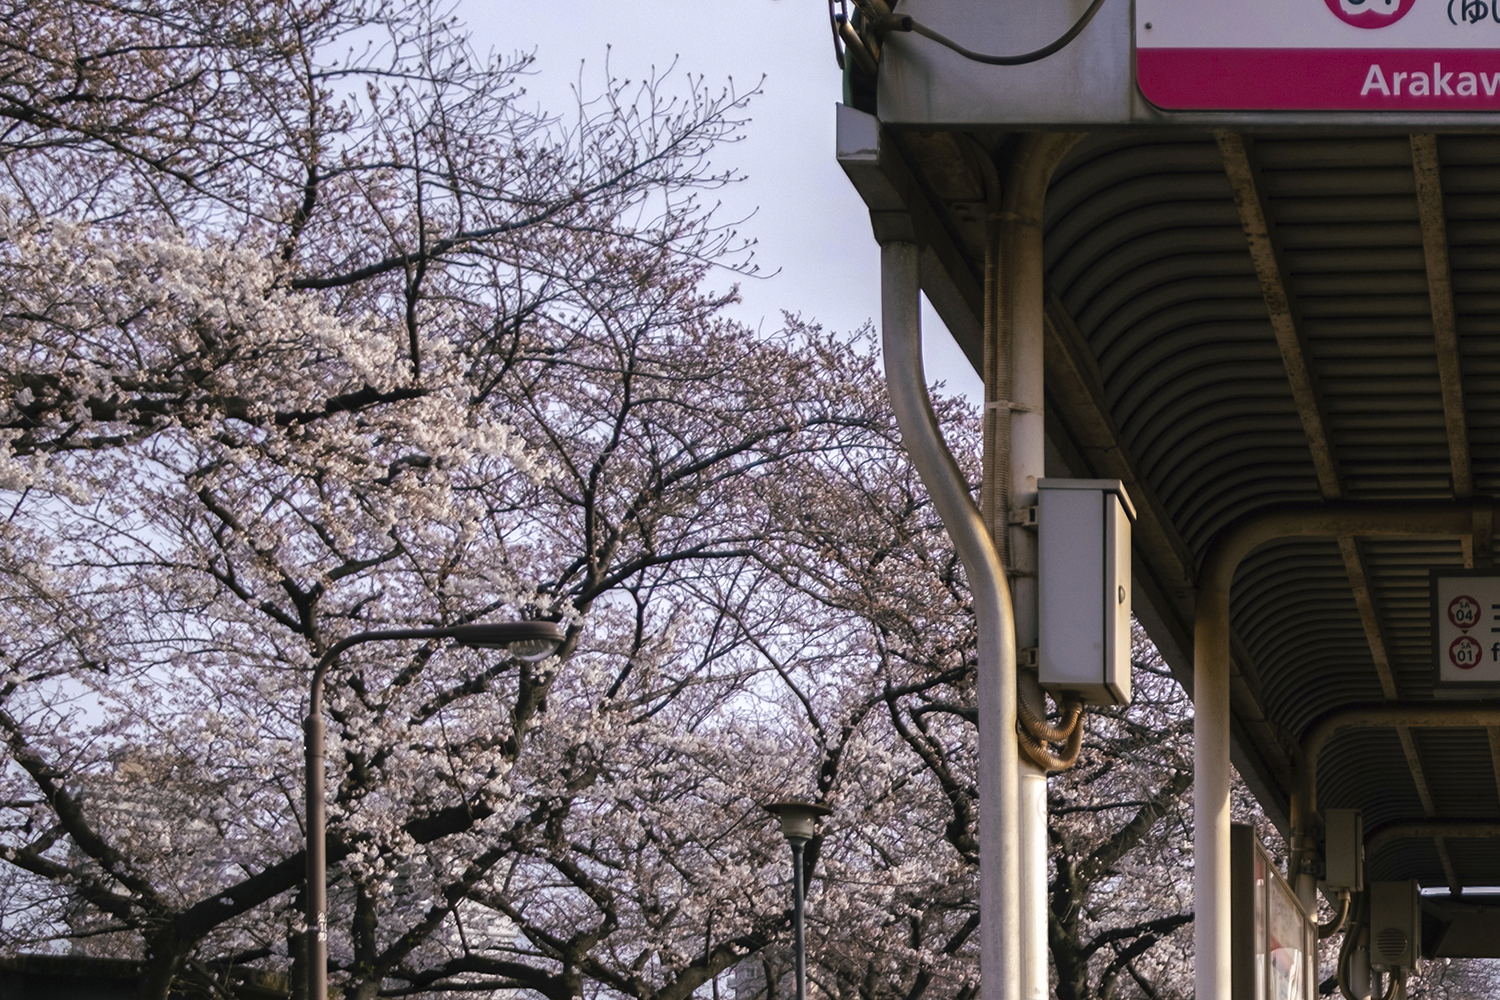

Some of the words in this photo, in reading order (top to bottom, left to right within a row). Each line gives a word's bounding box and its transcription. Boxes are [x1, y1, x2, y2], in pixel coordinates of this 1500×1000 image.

[1459, 601, 1471, 609] SA
[1456, 609, 1474, 621] 04
[1457, 650, 1473, 662] 01
